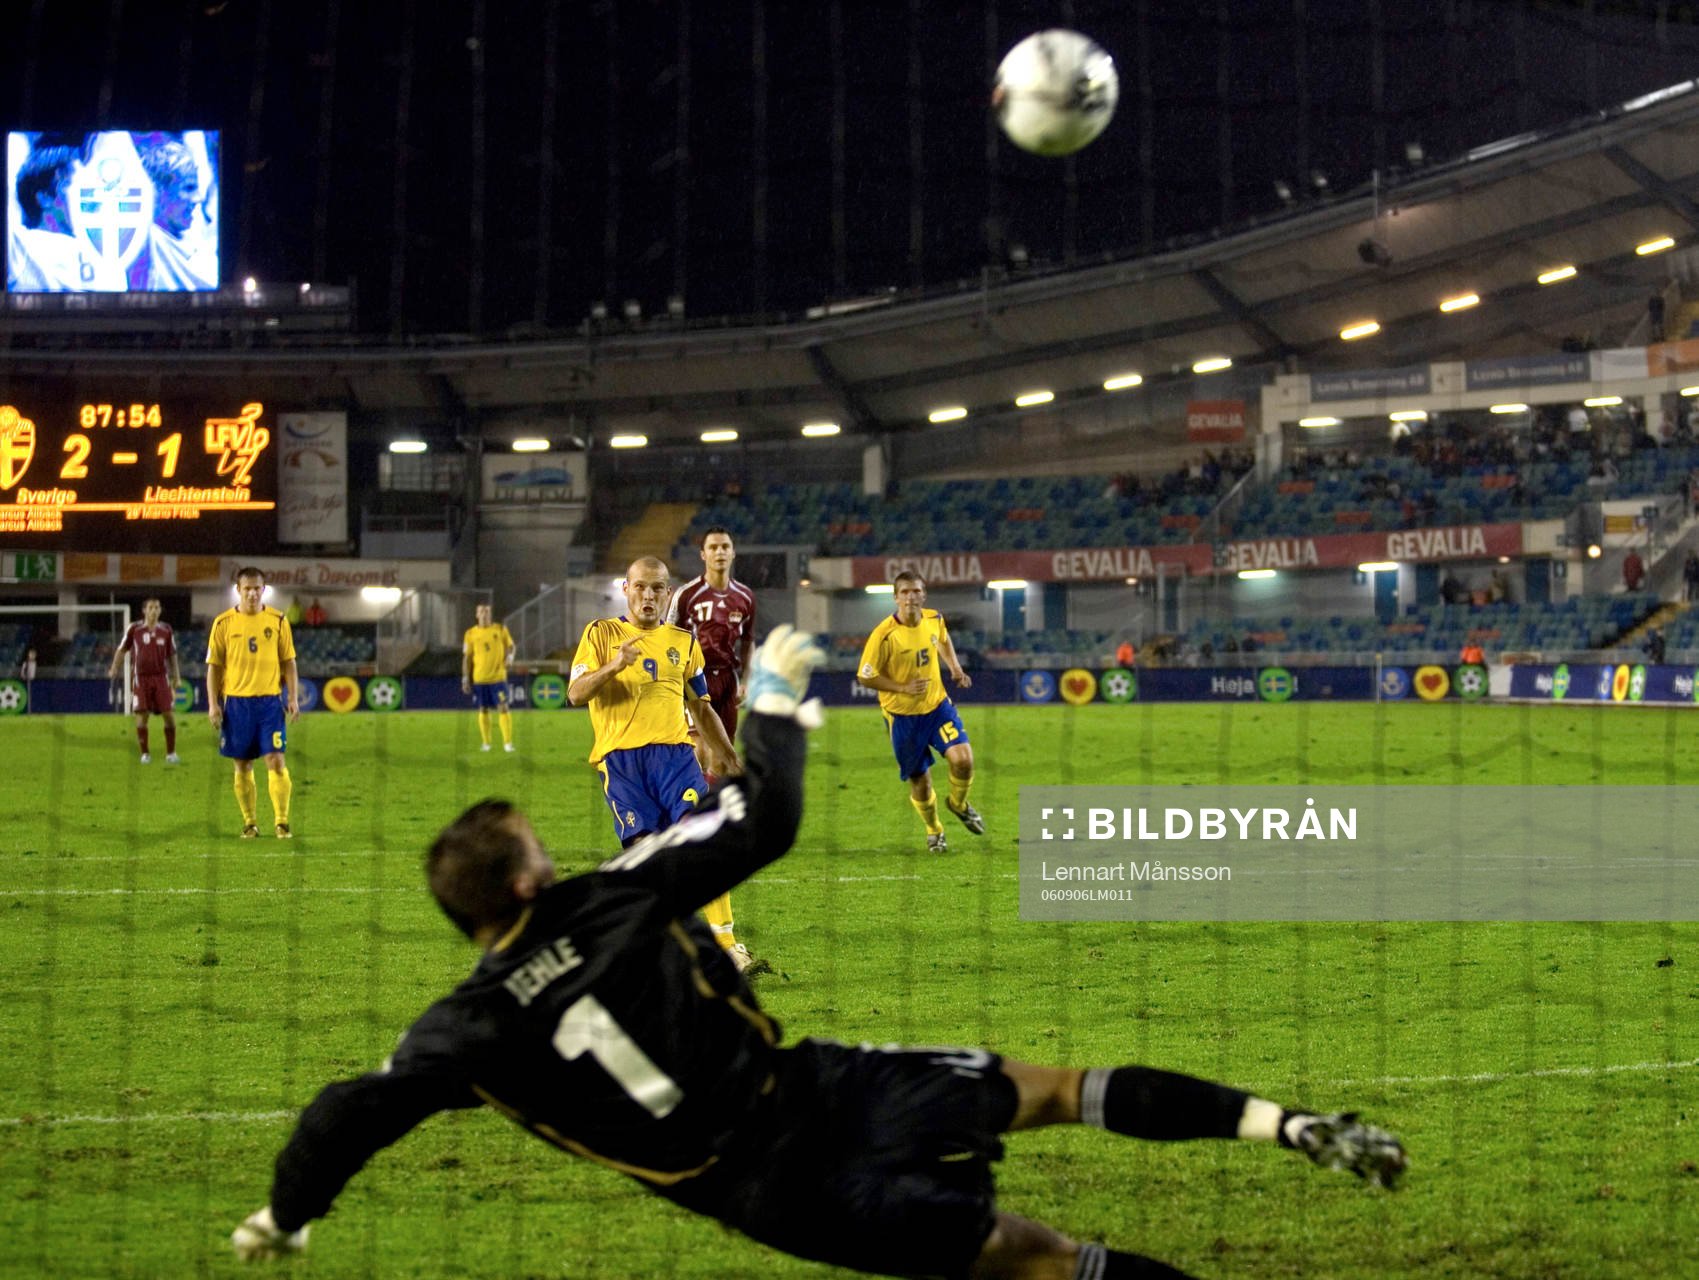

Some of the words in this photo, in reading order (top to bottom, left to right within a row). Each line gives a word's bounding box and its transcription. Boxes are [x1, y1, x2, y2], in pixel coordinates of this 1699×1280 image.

[80, 404, 161, 428] 87:54
[60, 434, 91, 479] 2
[157, 433, 182, 478] 1
[1387, 528, 1487, 559] GEVALIA
[1052, 549, 1153, 577] GEVALIA
[693, 600, 713, 621] 17
[248, 637, 258, 653] 6
[643, 658, 657, 681] 9
[916, 648, 930, 668] 15
[272, 731, 283, 749] 6
[940, 721, 959, 744] 15
[552, 993, 686, 1119] 1
